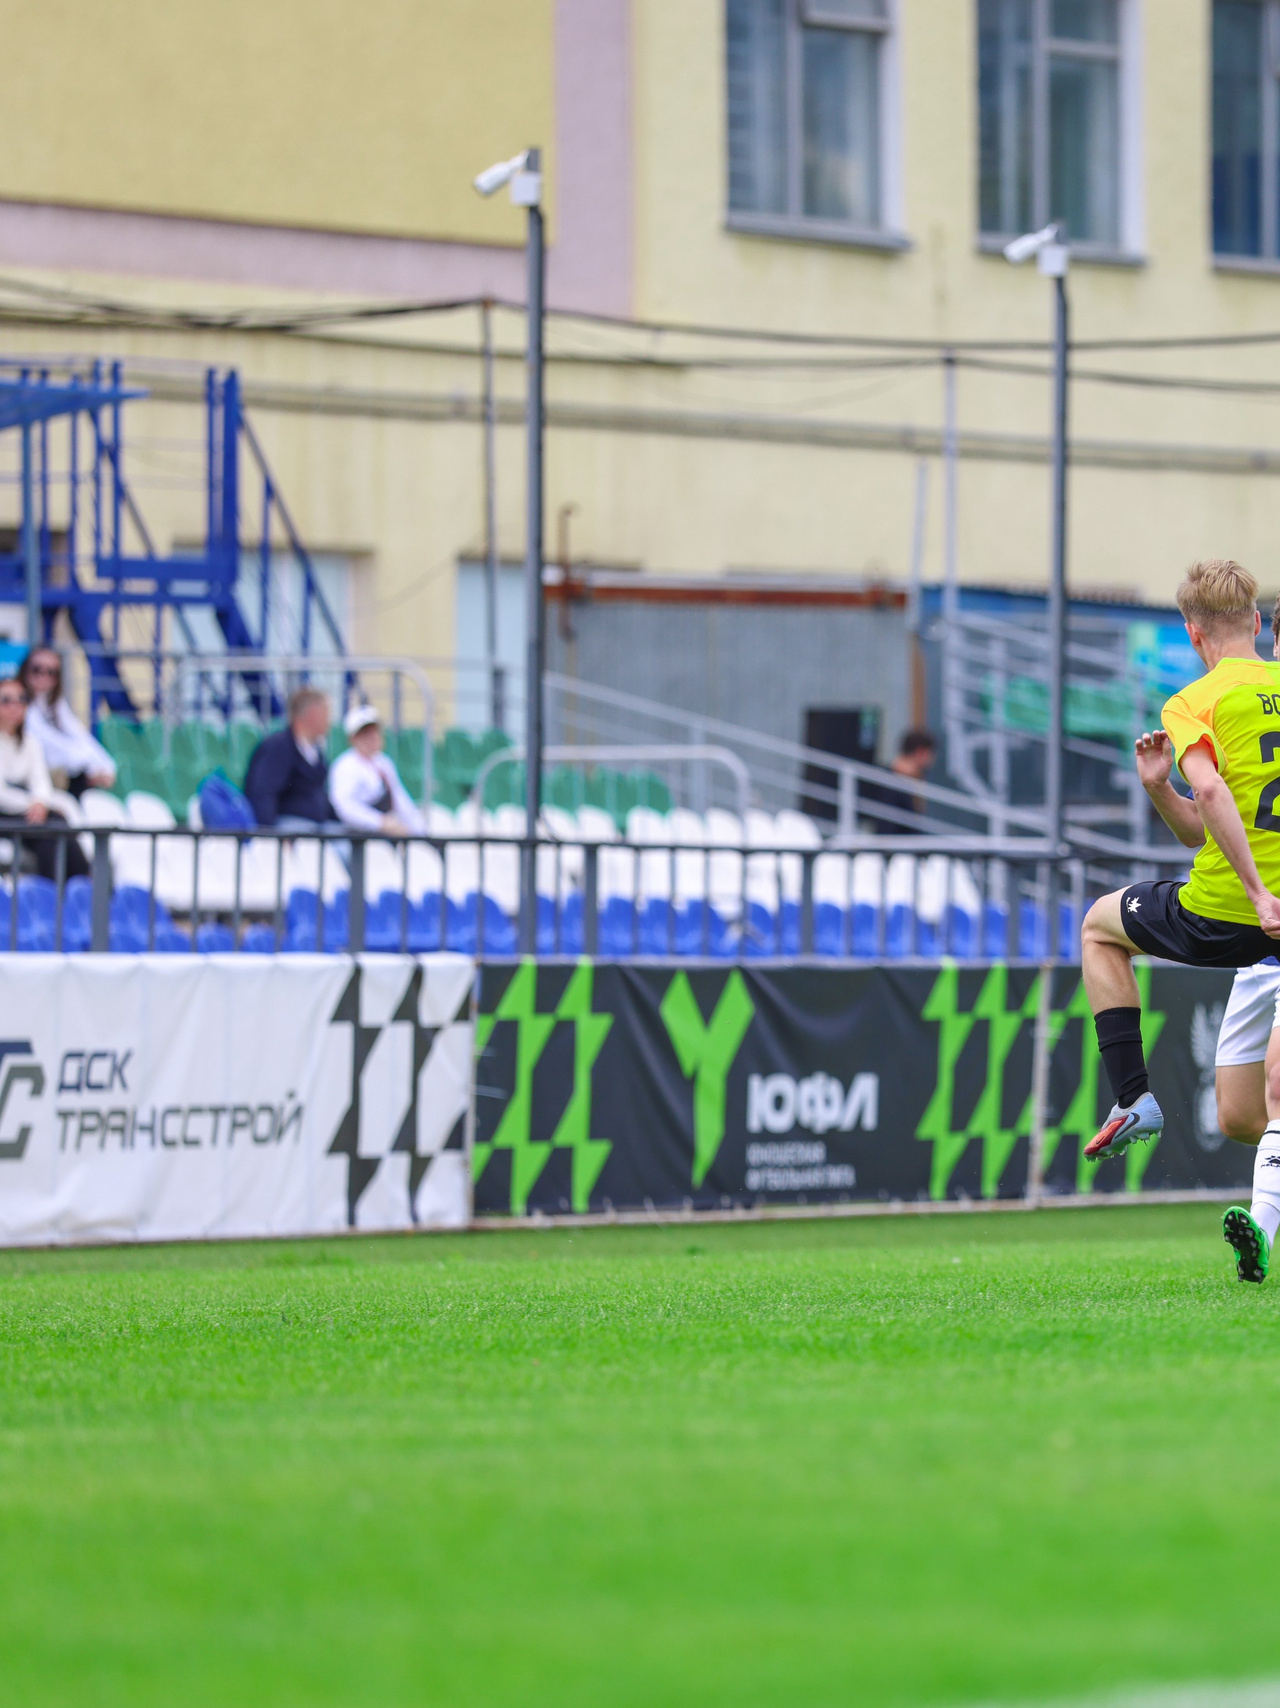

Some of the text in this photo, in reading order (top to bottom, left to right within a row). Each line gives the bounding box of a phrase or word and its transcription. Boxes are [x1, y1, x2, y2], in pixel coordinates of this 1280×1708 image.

[57, 1049, 133, 1093] ДСК
[747, 1071, 879, 1134] ЮФЛ
[56, 1089, 304, 1152] ТРАНССТРОЙ
